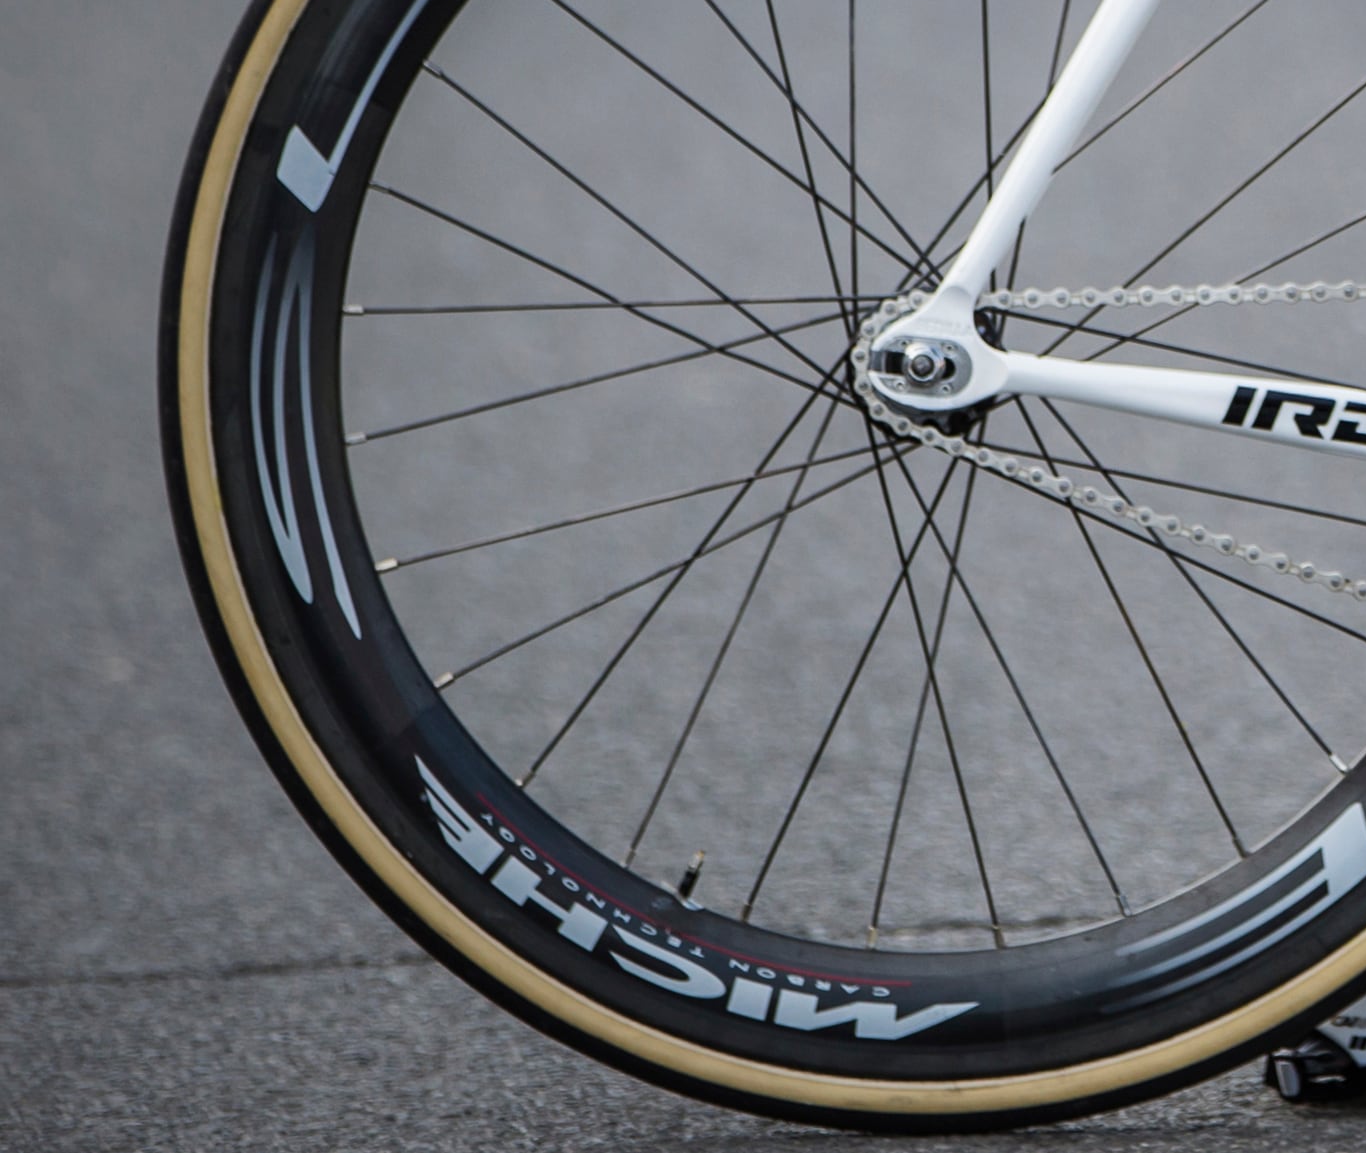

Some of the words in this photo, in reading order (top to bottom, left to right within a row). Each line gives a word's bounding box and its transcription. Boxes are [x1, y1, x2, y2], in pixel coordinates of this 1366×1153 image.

[412, 754, 982, 1040] MICHE
[482, 811, 706, 959] TECHNOLOGY
[728, 958, 892, 998] CARBON
